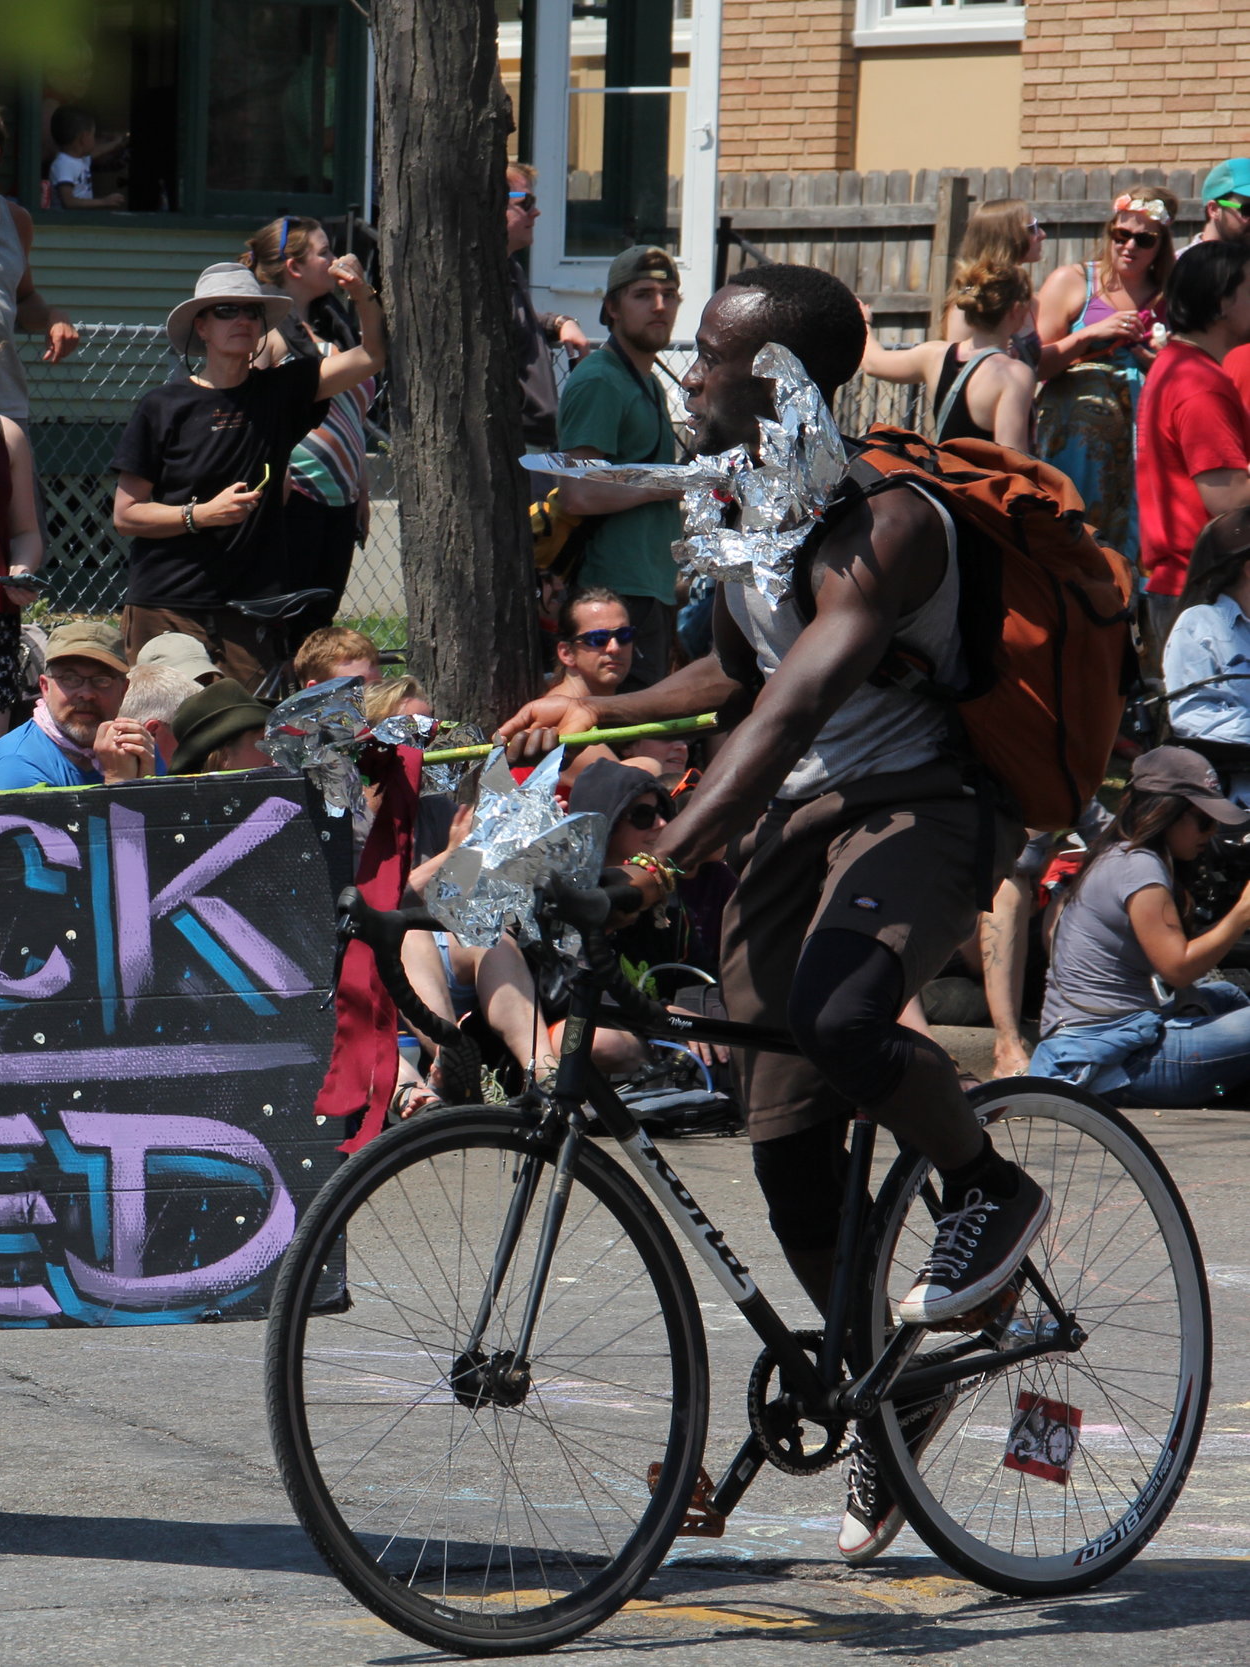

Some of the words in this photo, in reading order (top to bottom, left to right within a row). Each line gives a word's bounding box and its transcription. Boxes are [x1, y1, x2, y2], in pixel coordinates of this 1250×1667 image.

[1080, 1508, 1141, 1564] DP18
[1136, 1477, 1161, 1514] ULTIMATE
[1158, 1448, 1174, 1479] POWER
